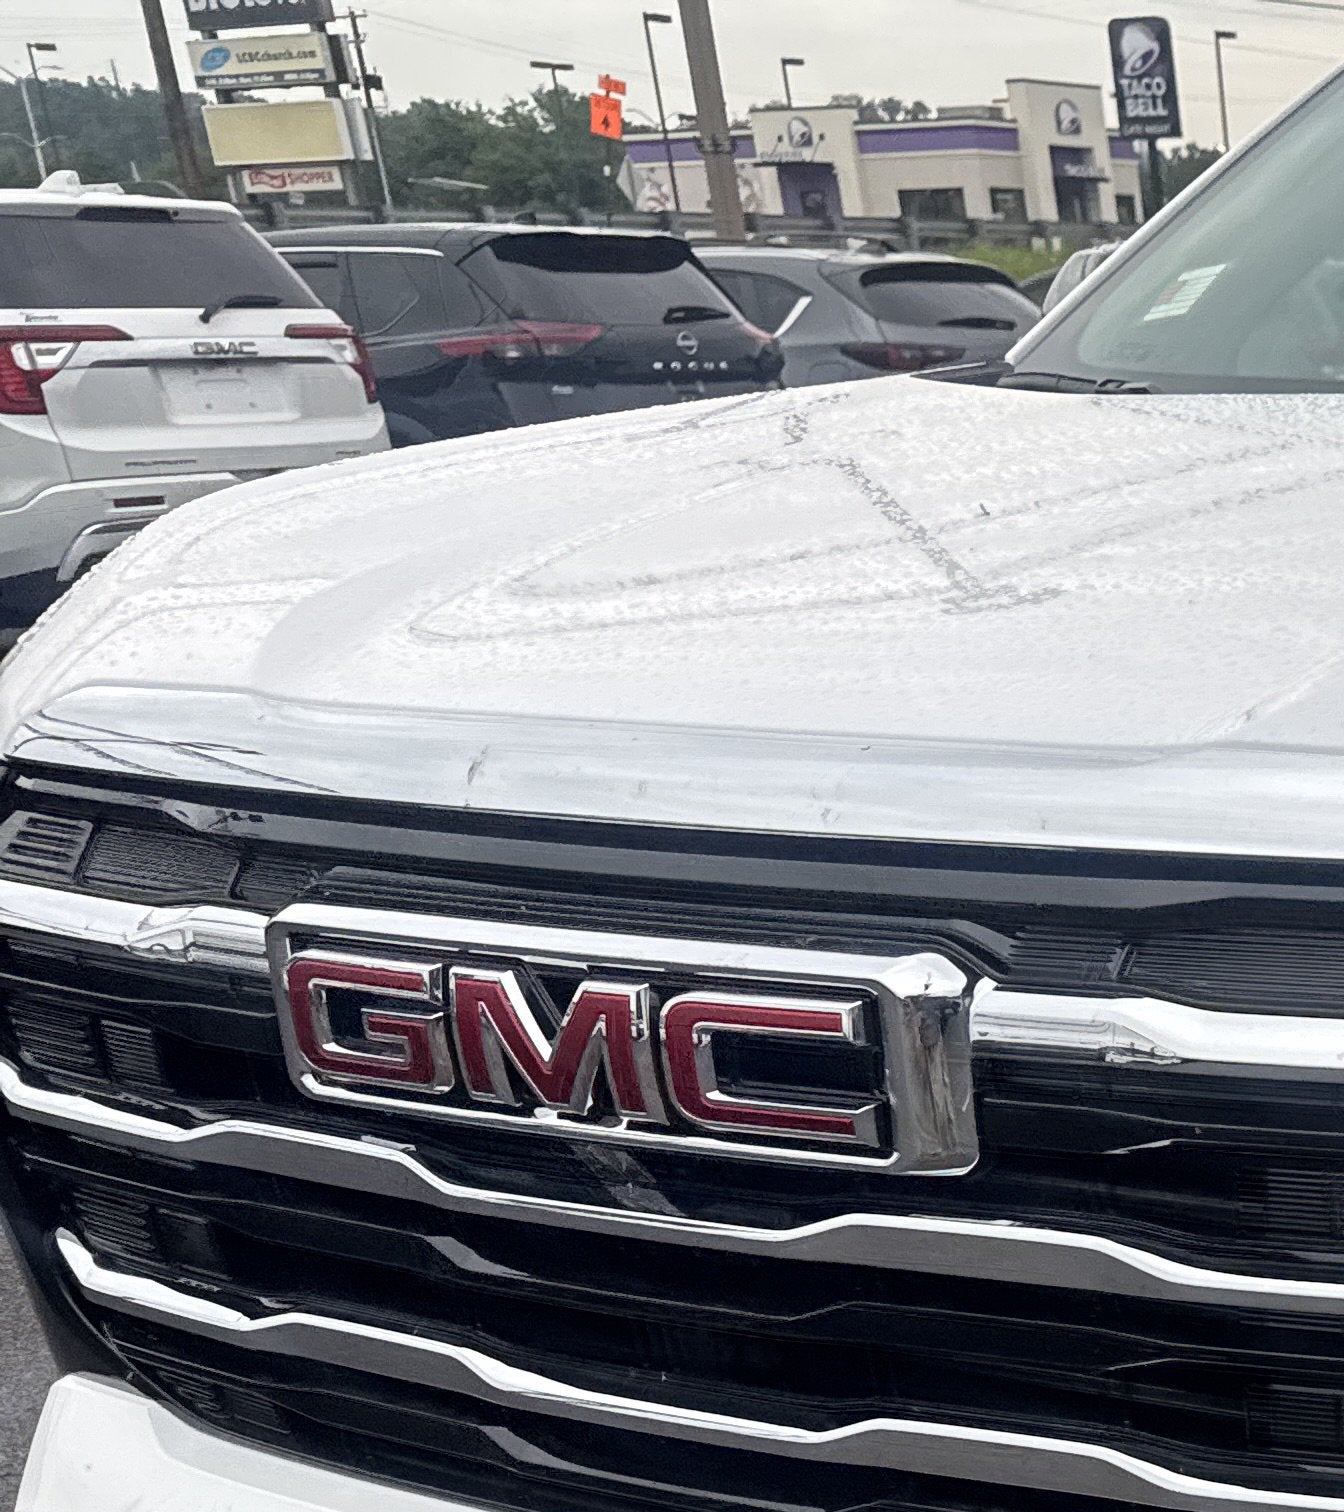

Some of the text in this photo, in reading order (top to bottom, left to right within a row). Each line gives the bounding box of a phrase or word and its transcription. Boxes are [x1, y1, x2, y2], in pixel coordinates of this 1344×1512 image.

[1119, 76, 1167, 97] TACO
[1124, 96, 1169, 118] BELL
[601, 114, 610, 131] 4
[287, 170, 335, 185] SHOPPER
[190, 341, 259, 356] GMC
[284, 949, 884, 1147] GMC
